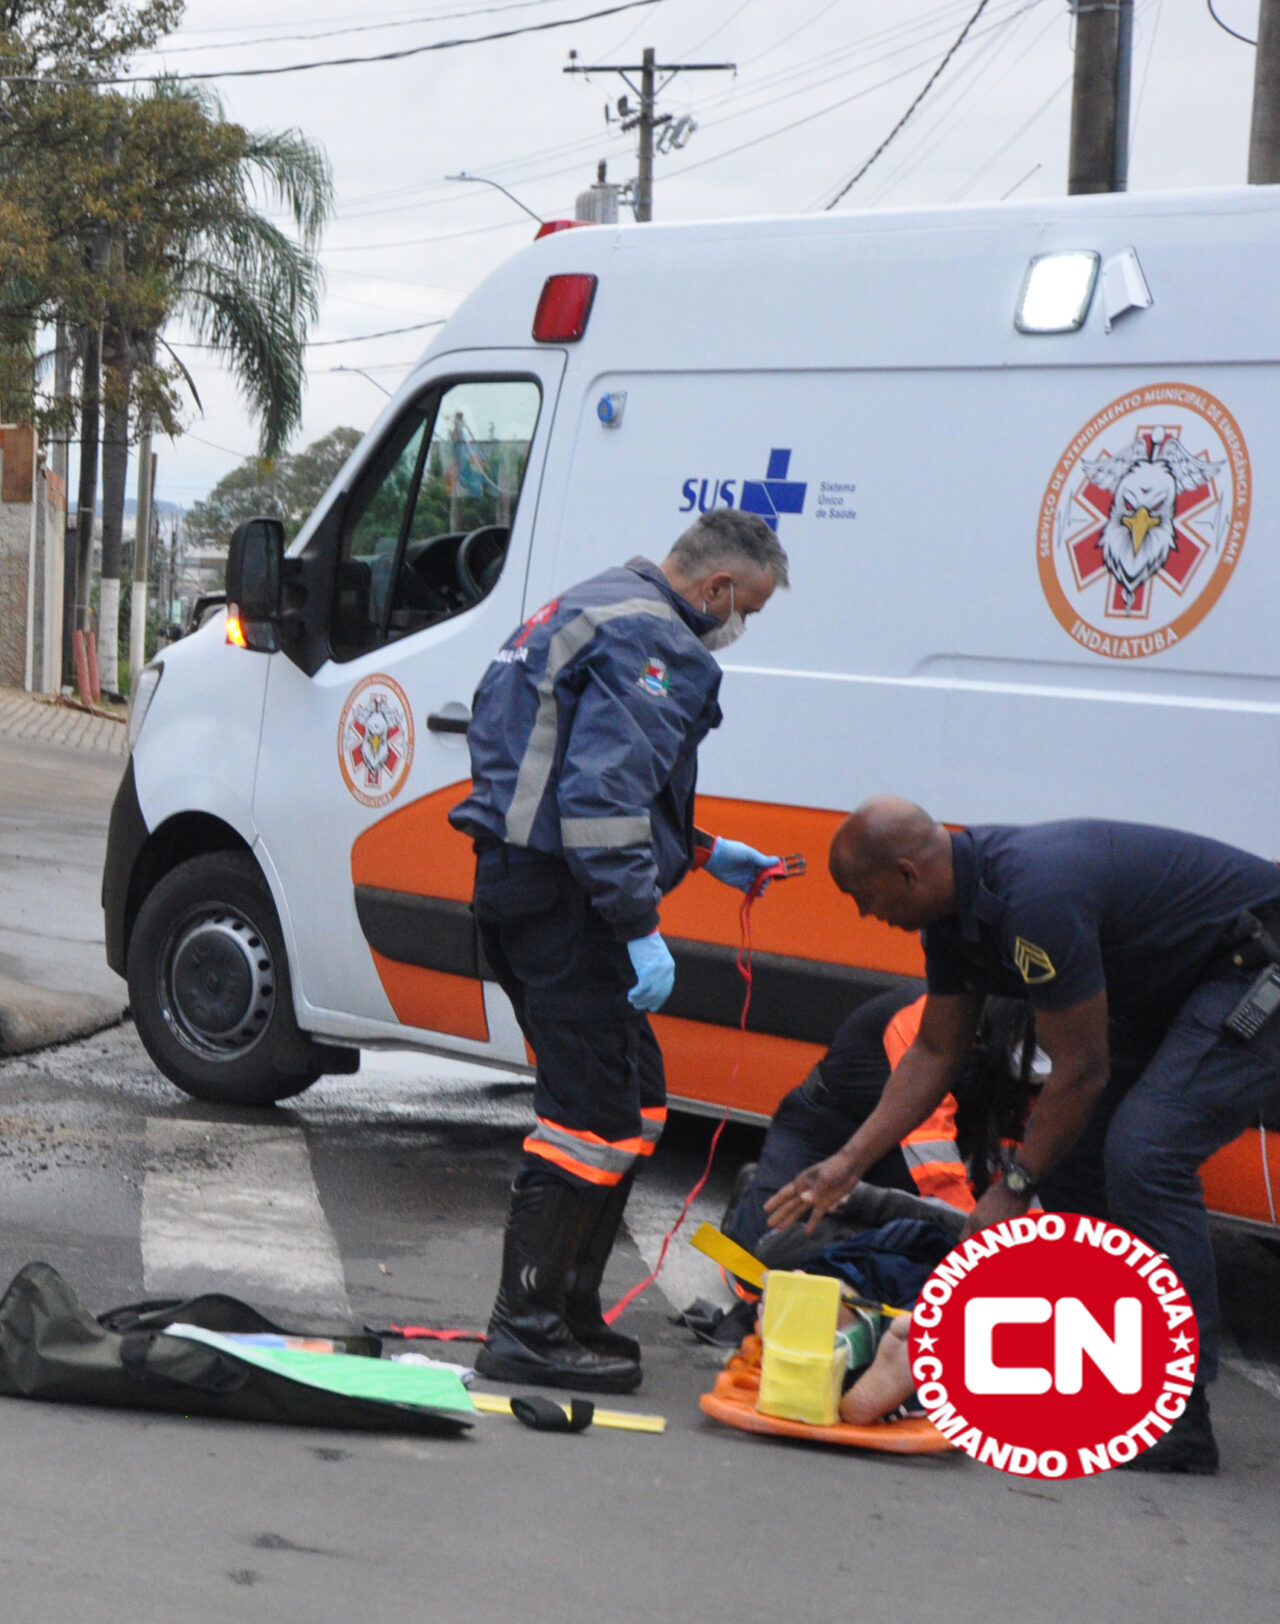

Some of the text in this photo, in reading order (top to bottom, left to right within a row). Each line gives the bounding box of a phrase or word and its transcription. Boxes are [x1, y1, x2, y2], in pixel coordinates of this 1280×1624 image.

[1144, 387, 1207, 411] MUNICIPAL
[1206, 403, 1224, 421] DE
[1062, 394, 1142, 473] ATENDIMENTO
[1050, 470, 1066, 490] DE
[1218, 418, 1249, 505] EMERGÊNCIA
[678, 477, 736, 514] SUS
[819, 481, 856, 493] Sistema
[816, 508, 827, 519] de
[1040, 493, 1057, 558] SERVIÇO
[1222, 519, 1246, 565] SAME
[1071, 618, 1179, 659] INDAIATUBA
